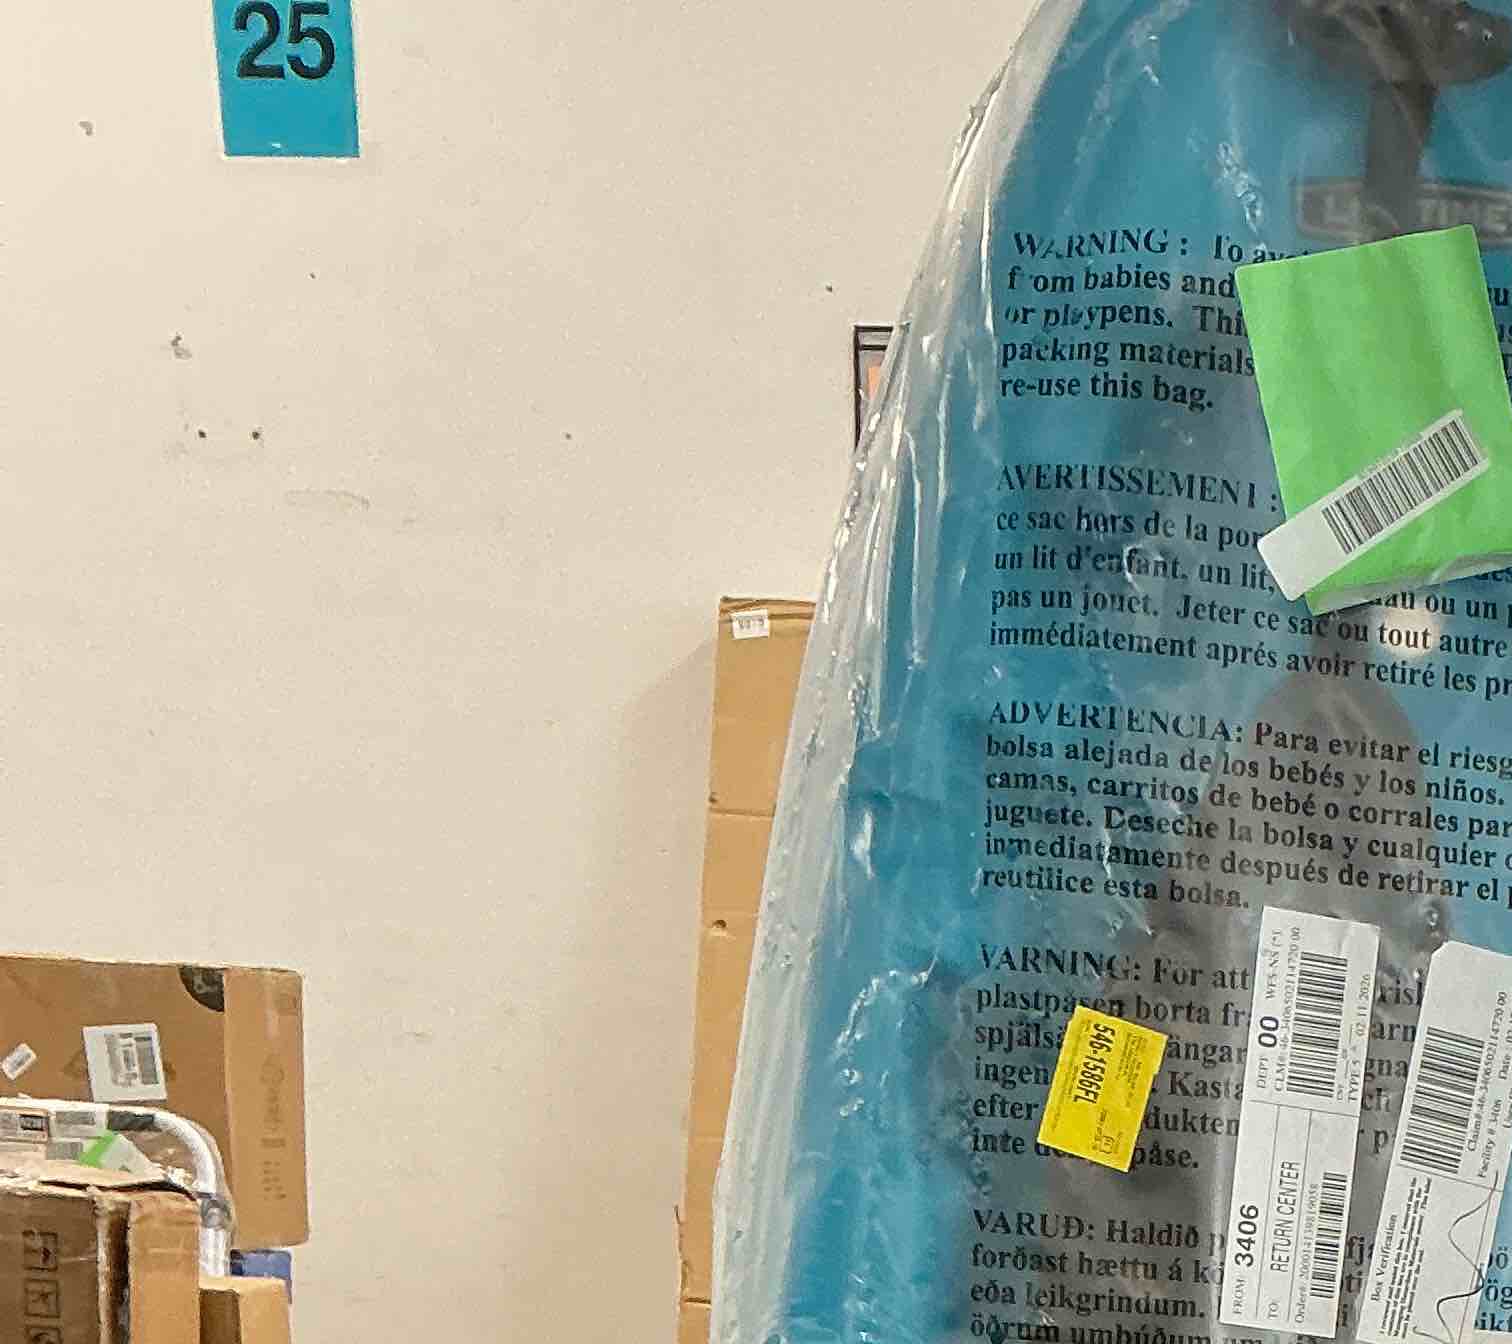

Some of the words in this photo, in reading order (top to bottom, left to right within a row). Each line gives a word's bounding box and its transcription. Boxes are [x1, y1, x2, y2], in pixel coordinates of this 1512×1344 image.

[234, 1, 336, 80] 25
[1000, 373, 1080, 398] re-use
[1091, 373, 1142, 398] this
[1153, 380, 1213, 411] bag.
[990, 620, 1196, 658] immédiatement
[1363, 657, 1434, 689] retiré
[1064, 738, 1168, 769] alejada
[1426, 779, 1503, 805] niños.
[1087, 778, 1199, 806] carritos
[1252, 787, 1315, 816] bebé
[1258, 1016, 1279, 1048] 00
[1477, 1138, 1495, 1178] Facility
[1276, 1161, 1300, 1216] CENTER
[1106, 1219, 1199, 1247] Haldið
[1234, 1204, 1259, 1268] 3406
[1270, 1219, 1294, 1272] RETURN
[1376, 1214, 1398, 1276] Verification
[971, 1243, 1067, 1273] forðast
[1079, 1250, 1157, 1281] hættu
[1370, 1281, 1383, 1301] Box
